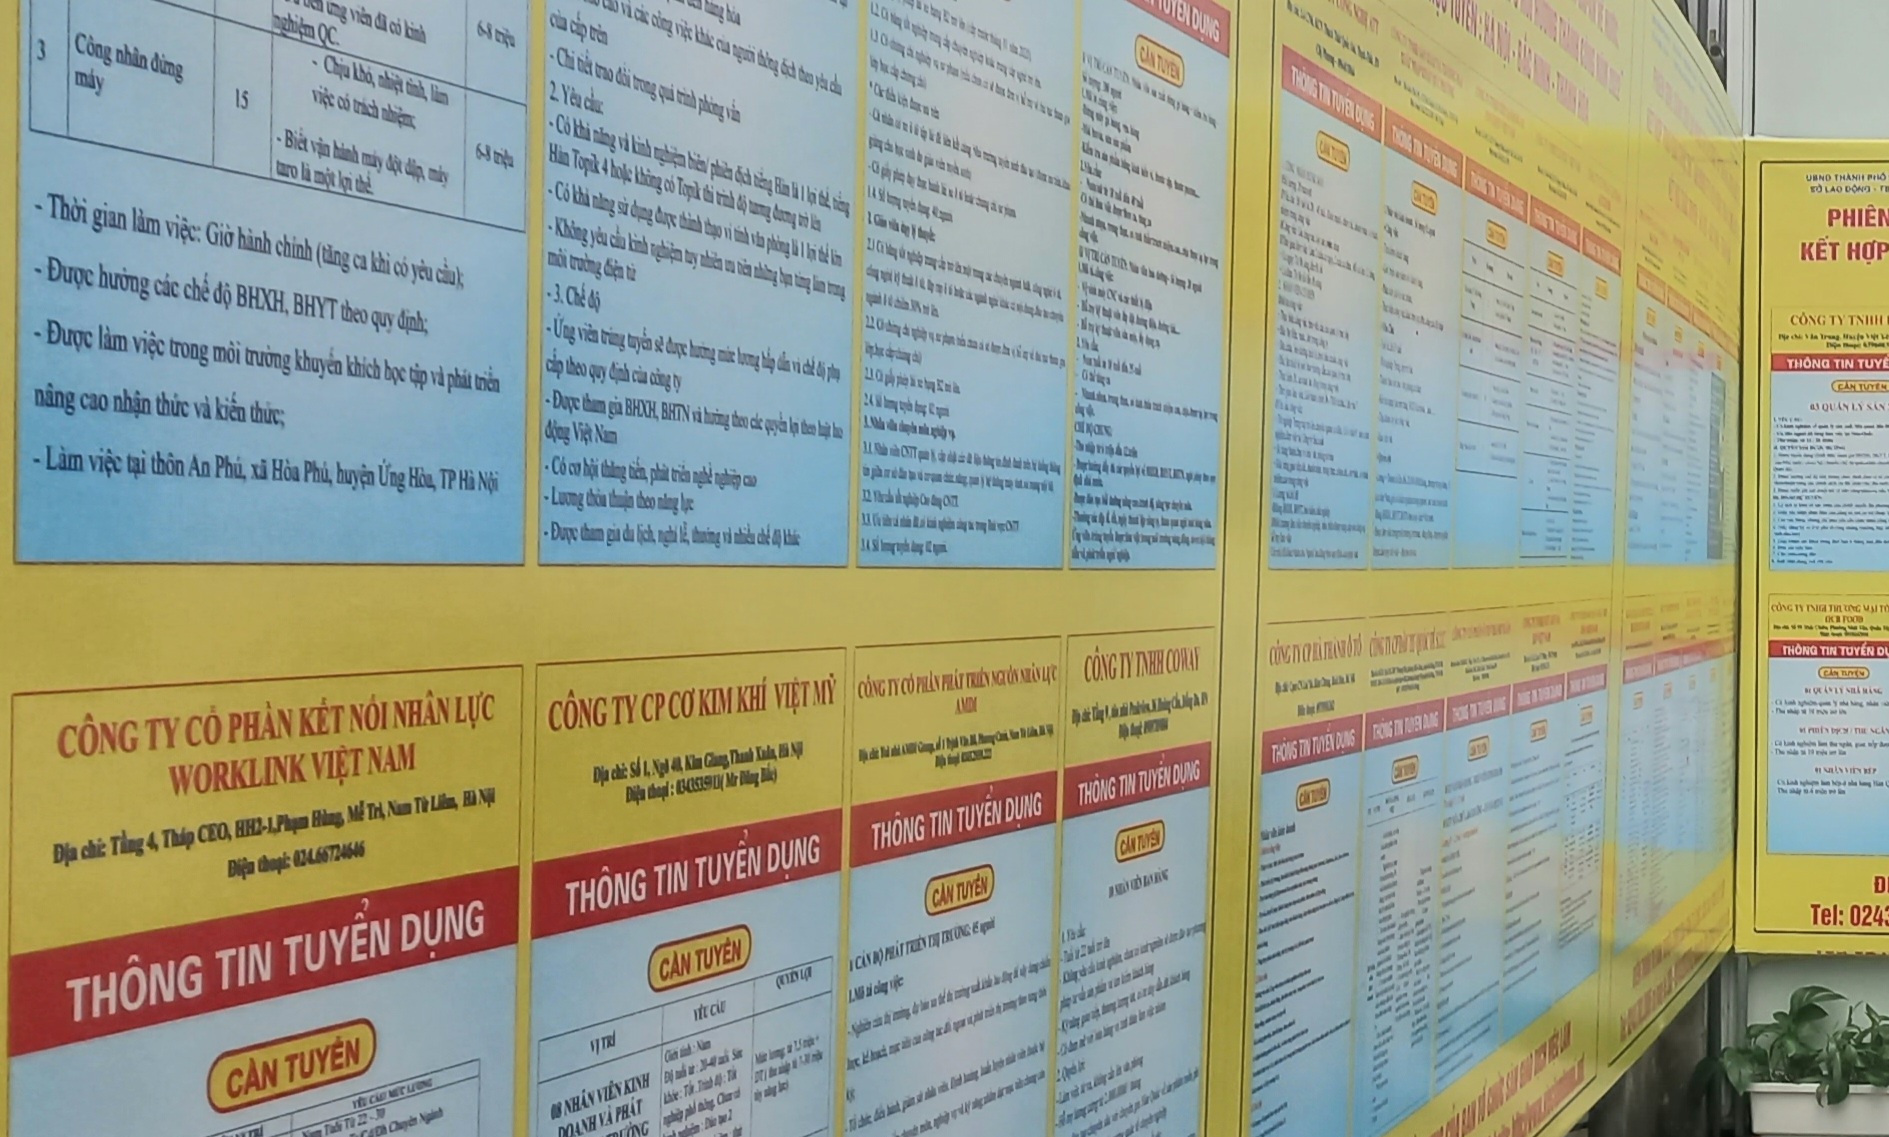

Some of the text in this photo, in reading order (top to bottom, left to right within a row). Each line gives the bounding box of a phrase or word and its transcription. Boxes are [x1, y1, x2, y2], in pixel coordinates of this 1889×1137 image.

[1847, 239, 1889, 266] HỢP
[48, 256, 94, 289] Được
[154, 273, 178, 297] các
[183, 273, 209, 302] chế
[213, 285, 232, 309] độ
[236, 284, 288, 316] BHXH,
[293, 292, 338, 318] BHYT
[340, 300, 368, 324] theo
[46, 446, 83, 473] Làm
[89, 448, 121, 478] việc
[189, 455, 210, 477] An
[378, 458, 404, 492] Ứng
[439, 468, 456, 490] TP
[458, 469, 474, 490] Hà
[57, 712, 139, 759] CÔNG
[145, 717, 179, 751] TY
[393, 690, 449, 728] NHÂN
[455, 690, 496, 729] LỰC
[548, 689, 607, 731] CÔNG
[612, 695, 638, 726] TY
[641, 694, 666, 723] CP
[669, 688, 695, 720] CƠ
[698, 687, 733, 716] KIM
[737, 677, 767, 713] KHÍ
[774, 677, 811, 715] VIỆT
[169, 742, 416, 795] WORKLINK VIỆT NAM
[1811, 904, 1844, 926] Tel:
[66, 898, 485, 1022] THÔNG TIN TUYỂN DỤNG
